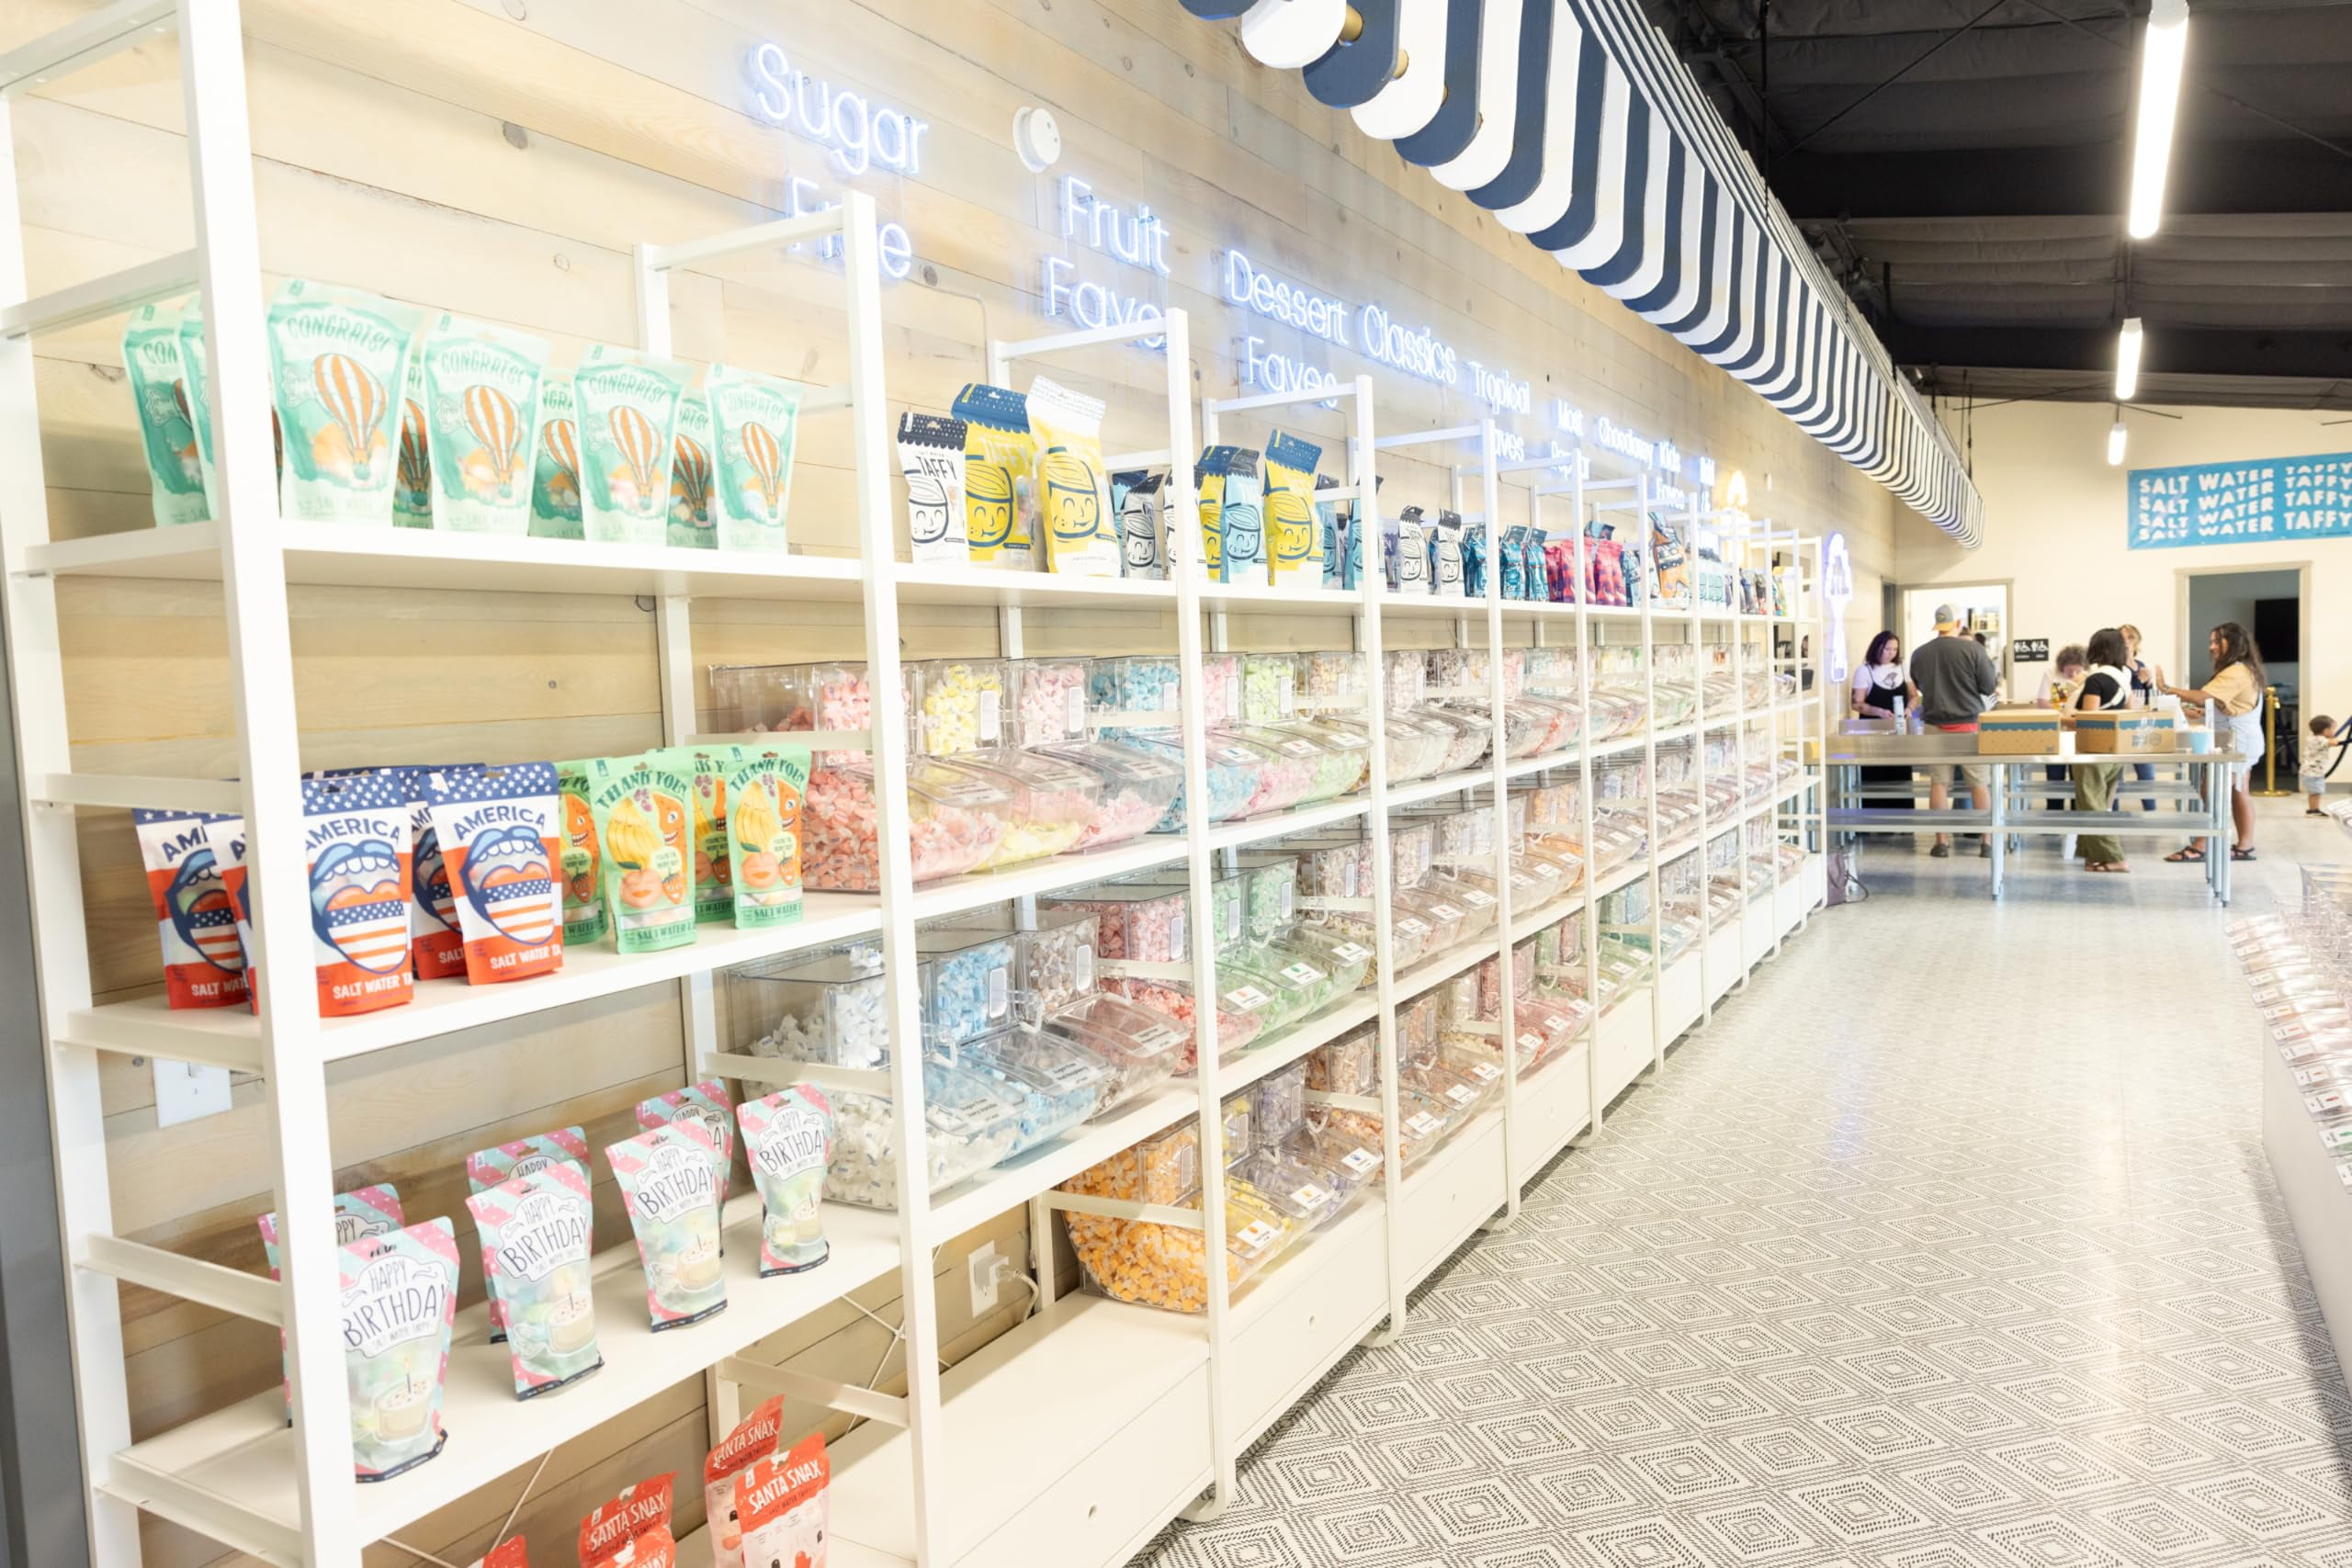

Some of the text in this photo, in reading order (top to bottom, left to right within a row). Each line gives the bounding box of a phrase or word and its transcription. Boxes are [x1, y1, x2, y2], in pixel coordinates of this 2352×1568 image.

[755, 43, 930, 175] Sugar
[791, 176, 913, 278] Fre
[1064, 175, 1171, 274] Fruit
[1048, 256, 1164, 347] Fave
[1228, 250, 1458, 385] Dessert Classics
[286, 314, 390, 353] CONGRATS!
[1468, 361, 1531, 414] Tropical
[1490, 427, 1525, 462] aves
[914, 455, 957, 480] TAFFY
[2139, 462, 2352, 494] SALT WATER TAFFY
[2139, 475, 2352, 514] SALT WATER TAFFY
[2139, 491, 2352, 529] SALT WATER TAFFY
[2139, 511, 2352, 541] SALT WATER TAFFY
[595, 770, 653, 808] THANK
[729, 758, 778, 792] THANK
[305, 818, 401, 852] AMERICA
[452, 805, 547, 840] AMERICA
[490, 953, 516, 970] SALT
[518, 946, 549, 964] WATER
[190, 982, 220, 997] SALT
[333, 982, 362, 999] SALT
[364, 974, 400, 994] WATER
[776, 1110, 802, 1134] HAPPY
[653, 1147, 681, 1171] HAPPY
[637, 1165, 716, 1215] BIRTHDAY
[521, 1195, 554, 1224] HAPPY
[504, 1215, 589, 1274] BIRTHDAY
[368, 1258, 407, 1293] HAPPY
[747, 1417, 779, 1446] SNAX
[749, 1459, 823, 1515] SANTA SNAX
[590, 1509, 630, 1552] SANTA
[630, 1485, 667, 1525] SNAX
